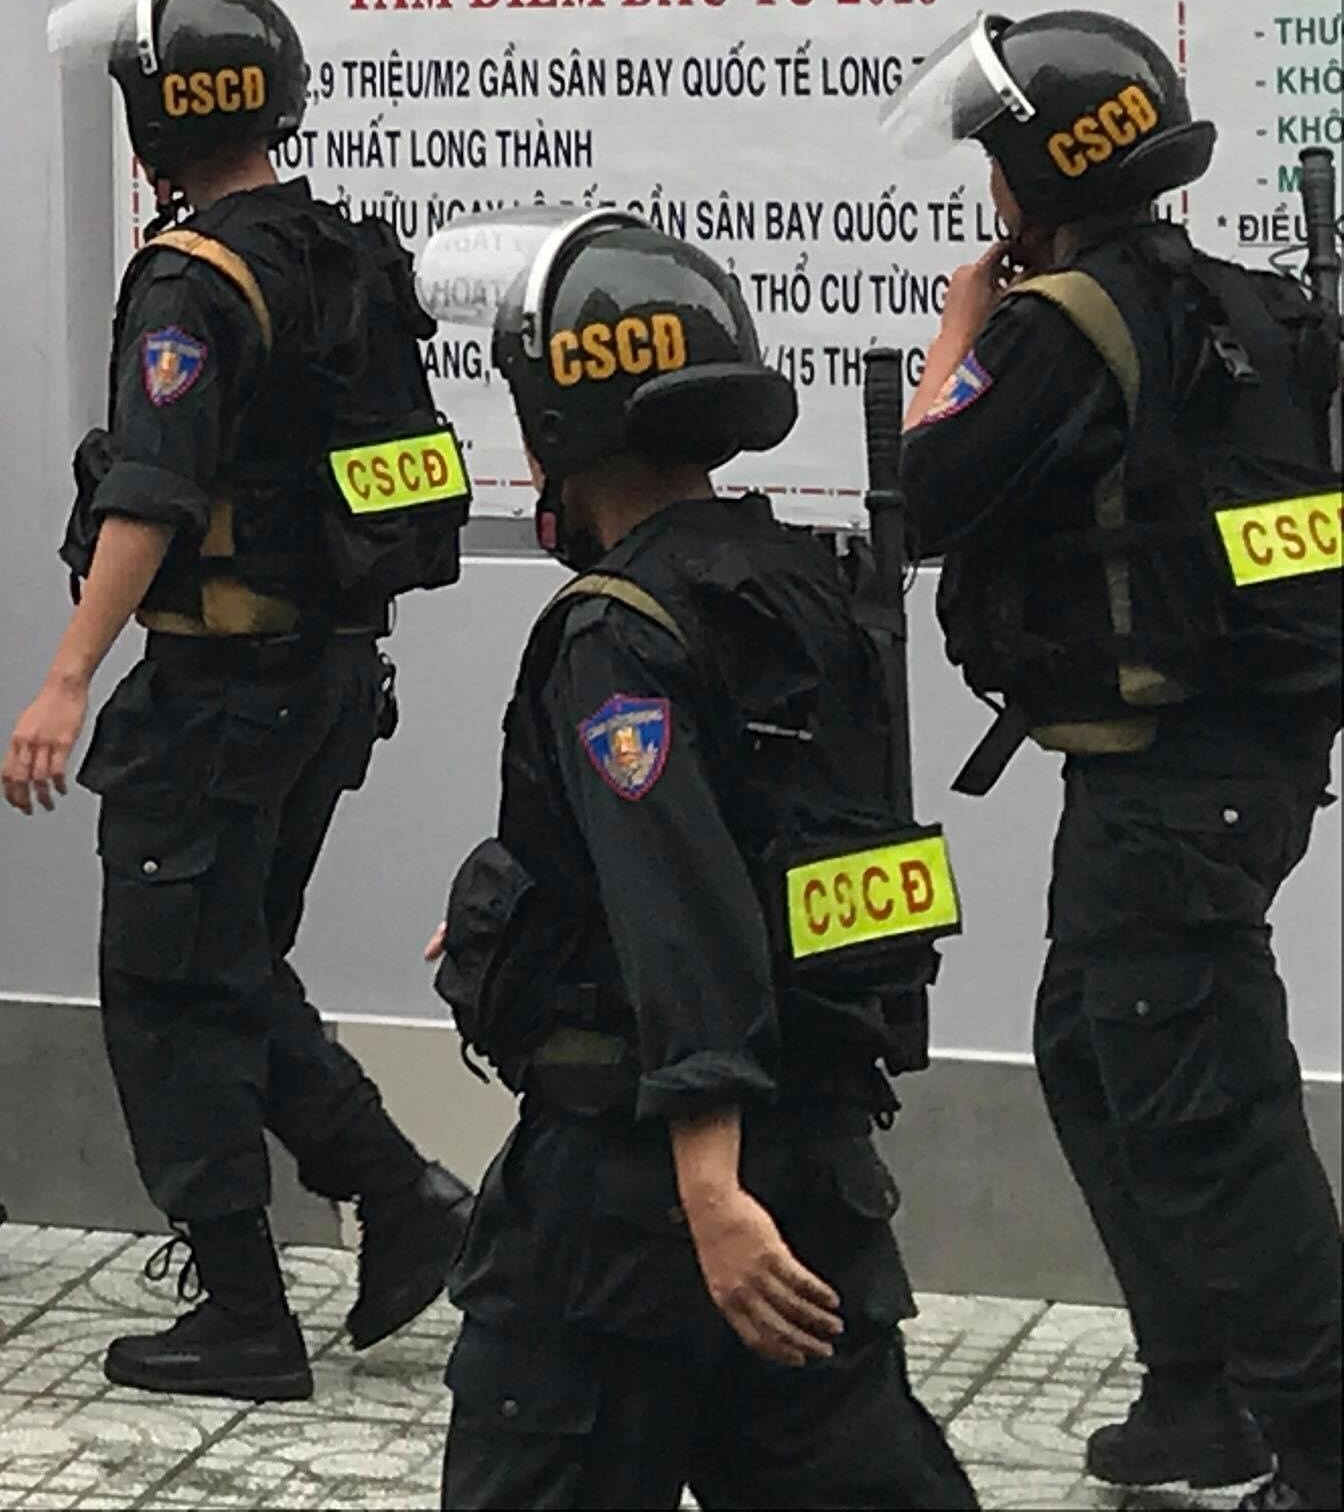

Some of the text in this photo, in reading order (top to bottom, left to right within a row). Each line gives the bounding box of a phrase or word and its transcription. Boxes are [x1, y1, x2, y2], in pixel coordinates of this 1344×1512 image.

[1274, 13, 1344, 45] THƯ
[342, 48, 470, 107] TRIỆU/M2
[479, 41, 539, 98] GẦN
[548, 47, 606, 98] SÂN
[616, 57, 672, 97] BAY
[682, 40, 766, 98] QUỐC
[774, 40, 811, 97] TẾ
[822, 56, 902, 97] LONG
[327, 113, 401, 168] NHẤT
[412, 129, 486, 168] LONG
[496, 118, 592, 168] THÀNH
[1048, 86, 1157, 177] CSCĐ
[696, 190, 754, 241] SÂN
[766, 201, 824, 241] BAY
[833, 184, 918, 243] QUỐC
[928, 184, 965, 242] TẾ
[750, 252, 811, 314] THỔ
[820, 268, 862, 314] CƯ
[869, 262, 950, 314] TỪNG
[550, 313, 686, 387] CSCĐ
[347, 448, 448, 501] CSCĐ
[1242, 508, 1344, 566] CSC
[803, 860, 935, 935] CSCĐ
